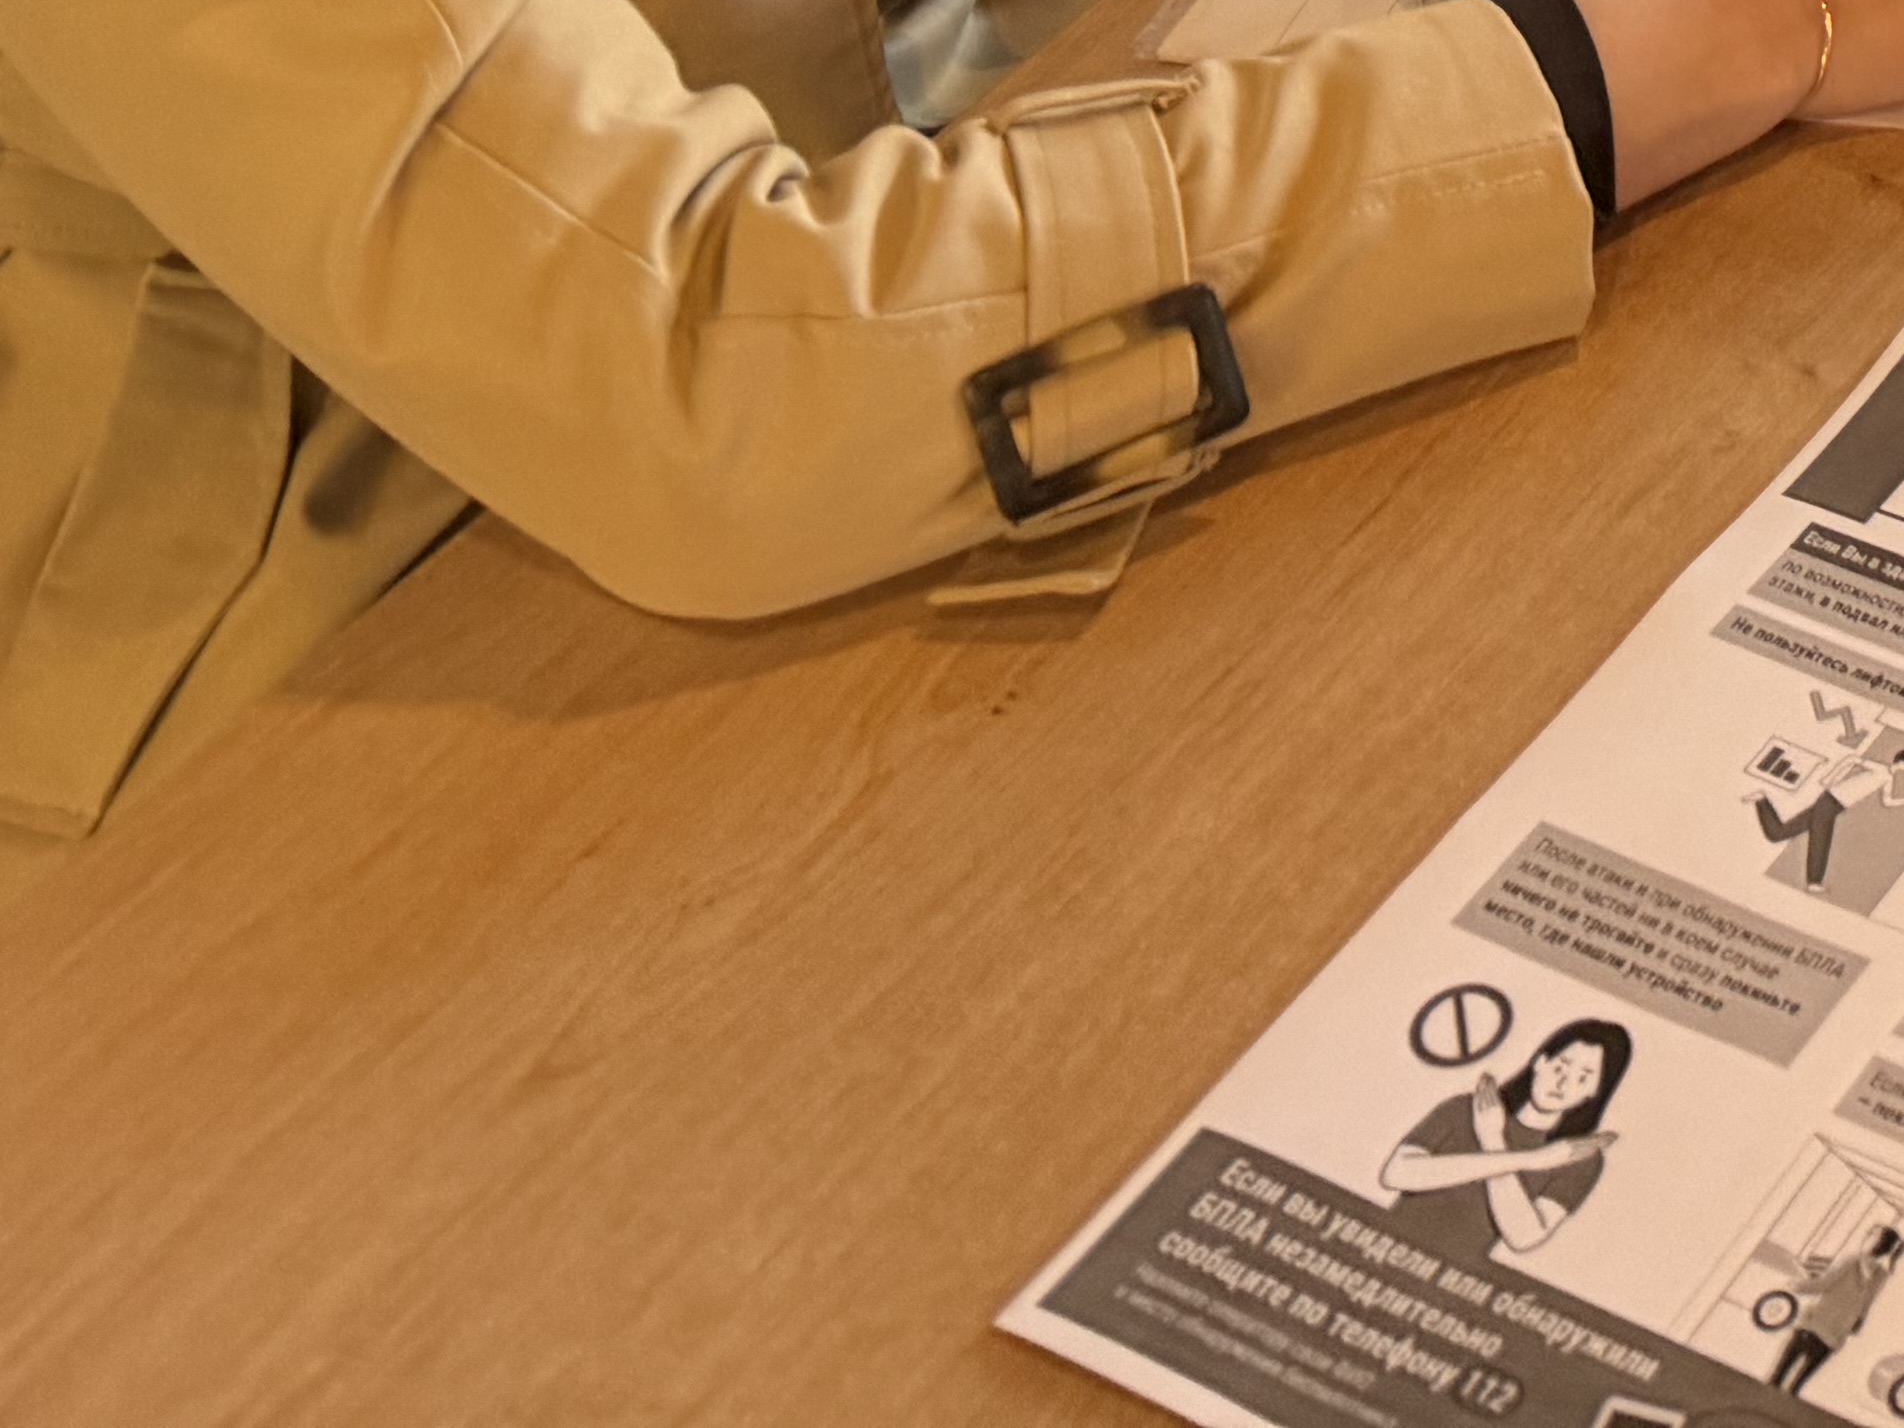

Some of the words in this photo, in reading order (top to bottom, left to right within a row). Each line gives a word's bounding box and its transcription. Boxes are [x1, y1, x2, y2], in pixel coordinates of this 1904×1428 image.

[1779, 560, 1804, 577] по
[1799, 530, 1845, 555] Если
[1838, 544, 1872, 565] Вы
[1727, 617, 1756, 637] Не
[1750, 626, 1853, 675] пользуйтесь
[1829, 600, 1890, 631] подвал
[1495, 880, 1559, 914] ничего
[1554, 904, 1582, 924] не
[1579, 914, 1658, 956] трогайте
[1531, 837, 1591, 870] После
[1585, 859, 1641, 891] атаки
[1648, 885, 1687, 910] при
[1681, 898, 1800, 957] обнаружении
[1794, 945, 1850, 978] БПЛА
[1567, 938, 1628, 971] нашли
[1624, 961, 1727, 1013] устройство
[1184, 1191, 1274, 1246] БПЛА
[1261, 1226, 1511, 1358] незамедлительно
[1214, 1157, 1292, 1208] Если
[1279, 1187, 1335, 1229] вы
[1321, 1206, 1448, 1282] увидели
[1434, 1258, 1501, 1306] или
[1487, 1283, 1666, 1384] обнаружили
[1151, 1229, 1297, 1310] сообщите
[1284, 1290, 1333, 1327] по
[1322, 1307, 1466, 1389] телефону
[1453, 1367, 1521, 1414] 112
